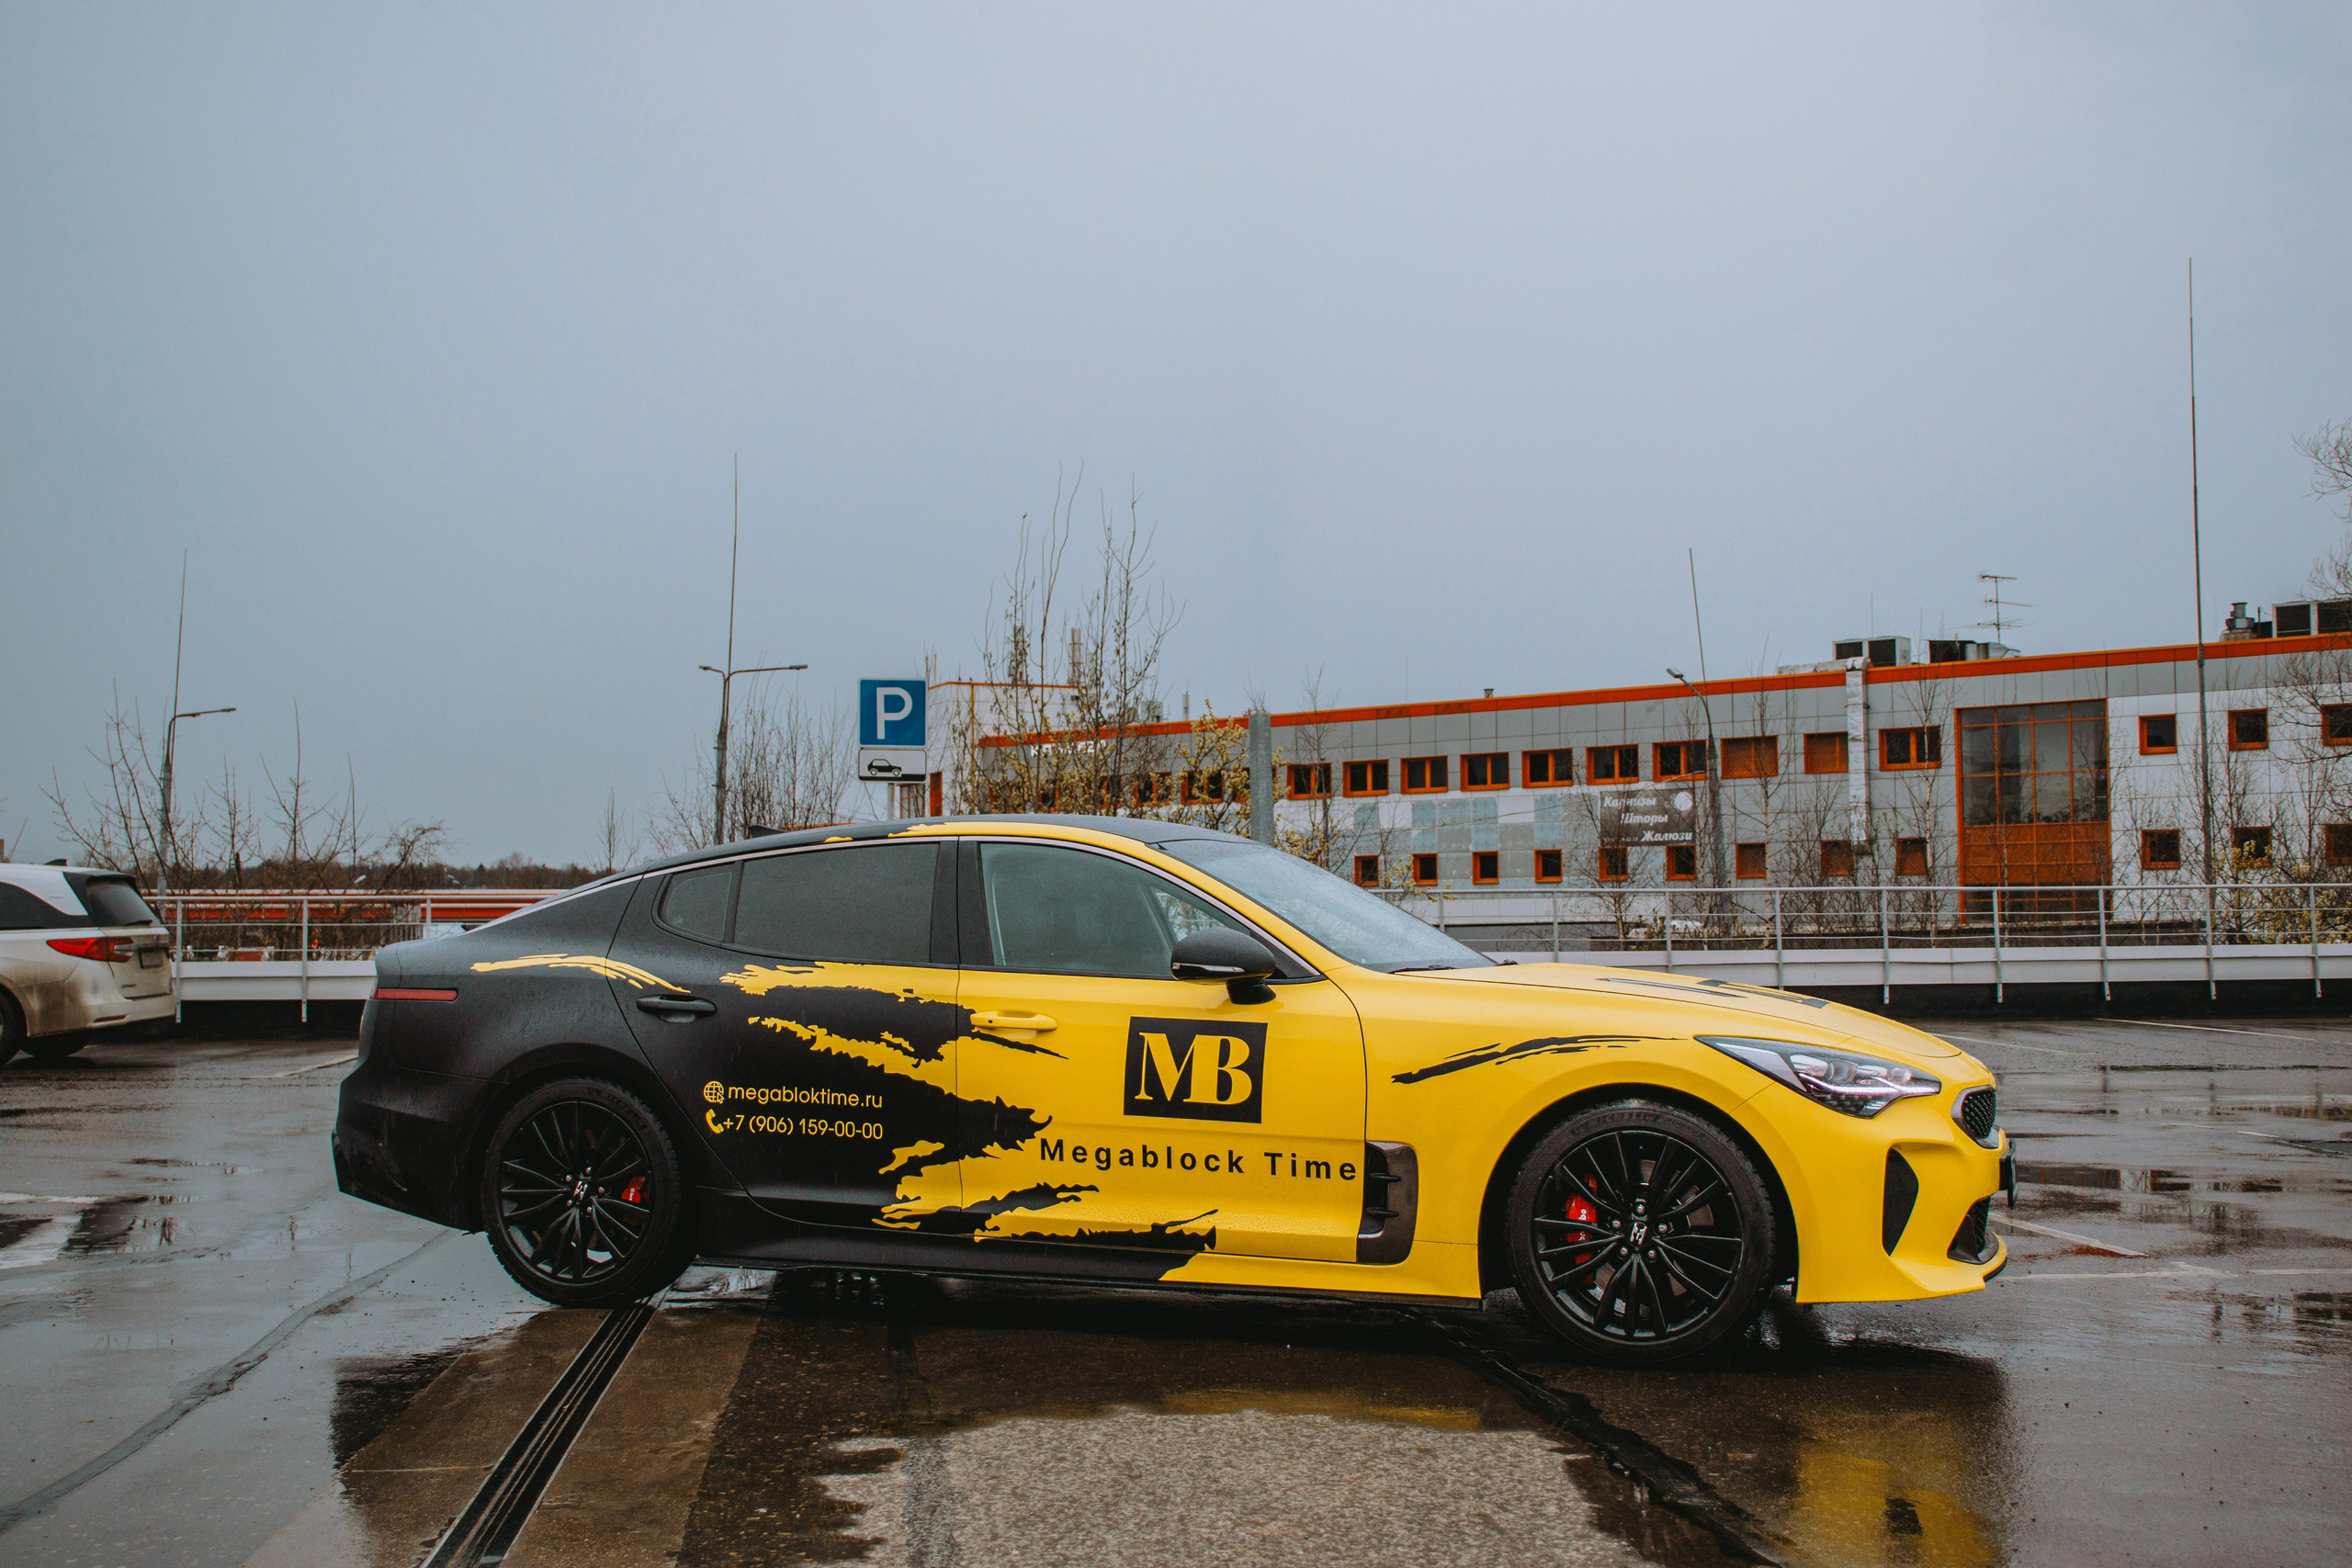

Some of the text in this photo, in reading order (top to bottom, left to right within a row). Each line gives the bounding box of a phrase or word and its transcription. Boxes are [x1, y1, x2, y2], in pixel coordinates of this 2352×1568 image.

[876, 687, 912, 739] P
[1620, 813, 1668, 826] Шторы
[1640, 830, 1692, 841] Жалюзи
[1135, 1032, 1252, 1105] MB
[728, 1086, 883, 1108] megabloktime.ru
[723, 1115, 883, 1139] +7 (906) 159-00-00
[1040, 1137, 1357, 1181] Megablock Time
